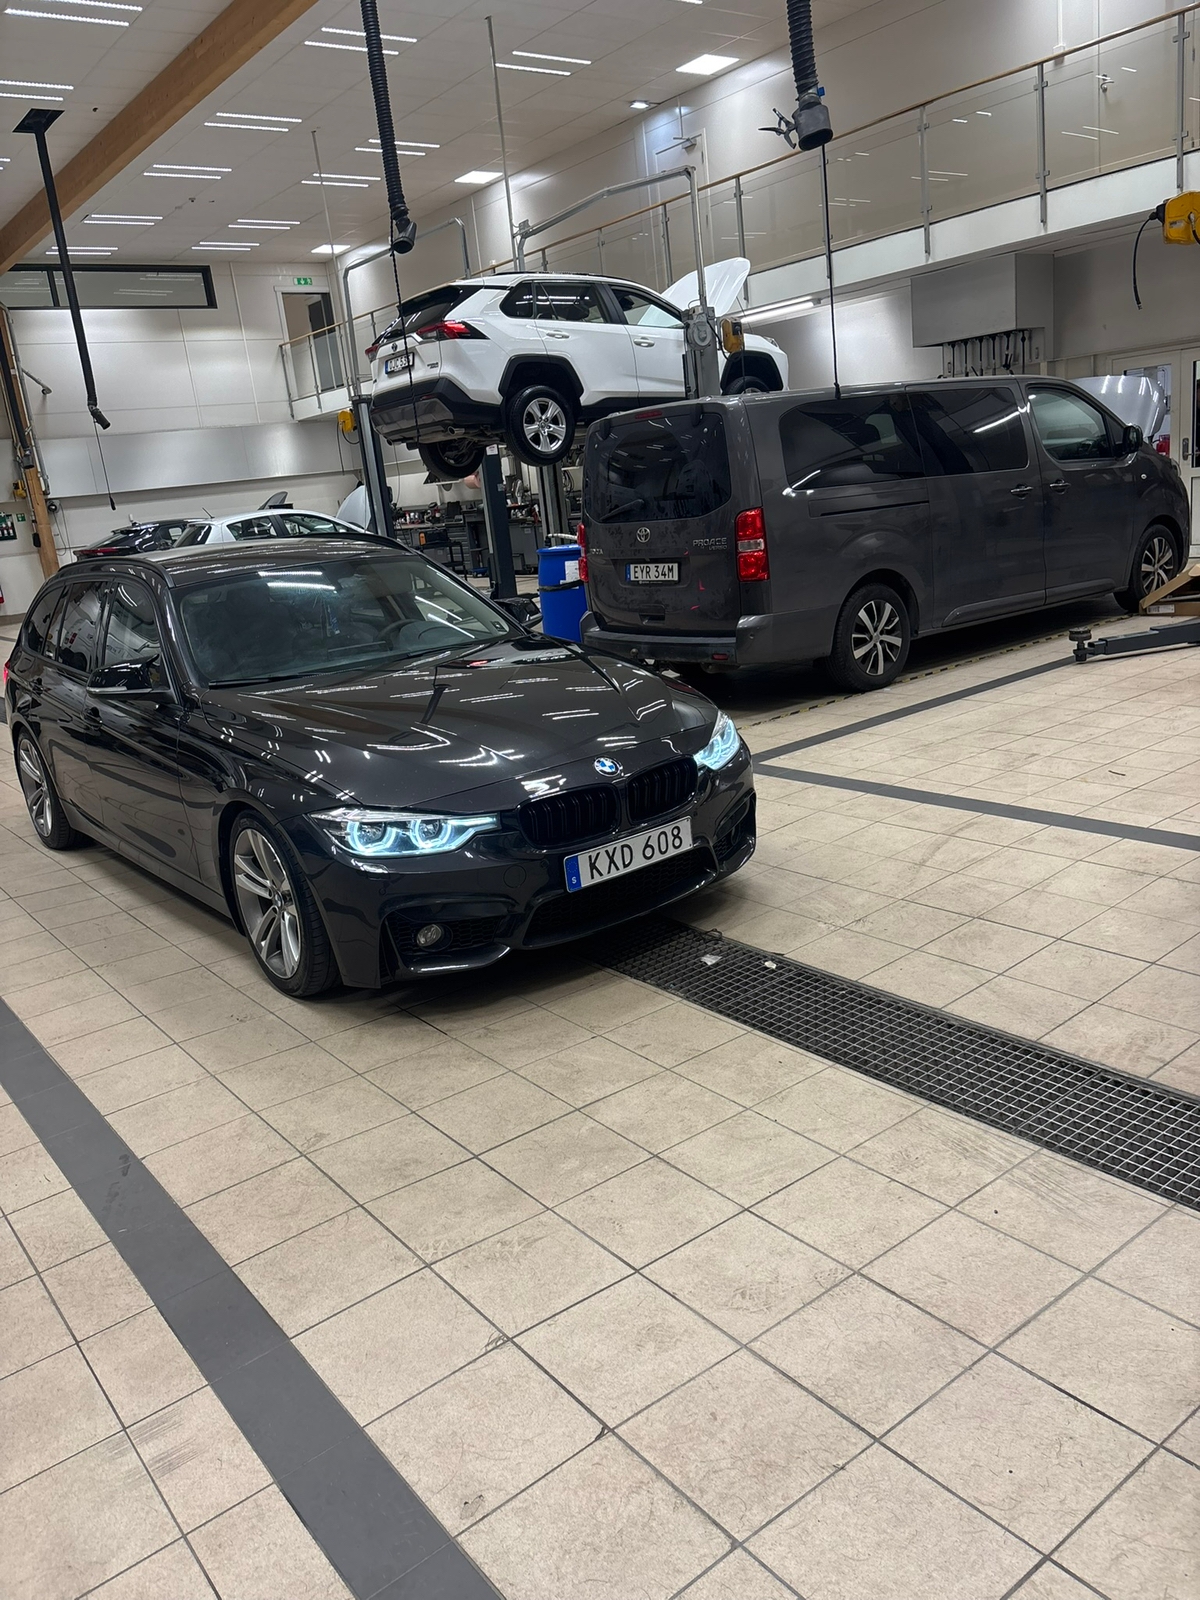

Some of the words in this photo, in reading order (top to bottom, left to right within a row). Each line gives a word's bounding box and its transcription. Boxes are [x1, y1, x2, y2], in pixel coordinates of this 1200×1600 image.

[692, 537, 727, 547] PROACE
[633, 565, 651, 579] EYR
[654, 565, 674, 579] 34M
[588, 843, 633, 879] KXD
[642, 826, 683, 860] 608
[571, 876, 577, 884] S
